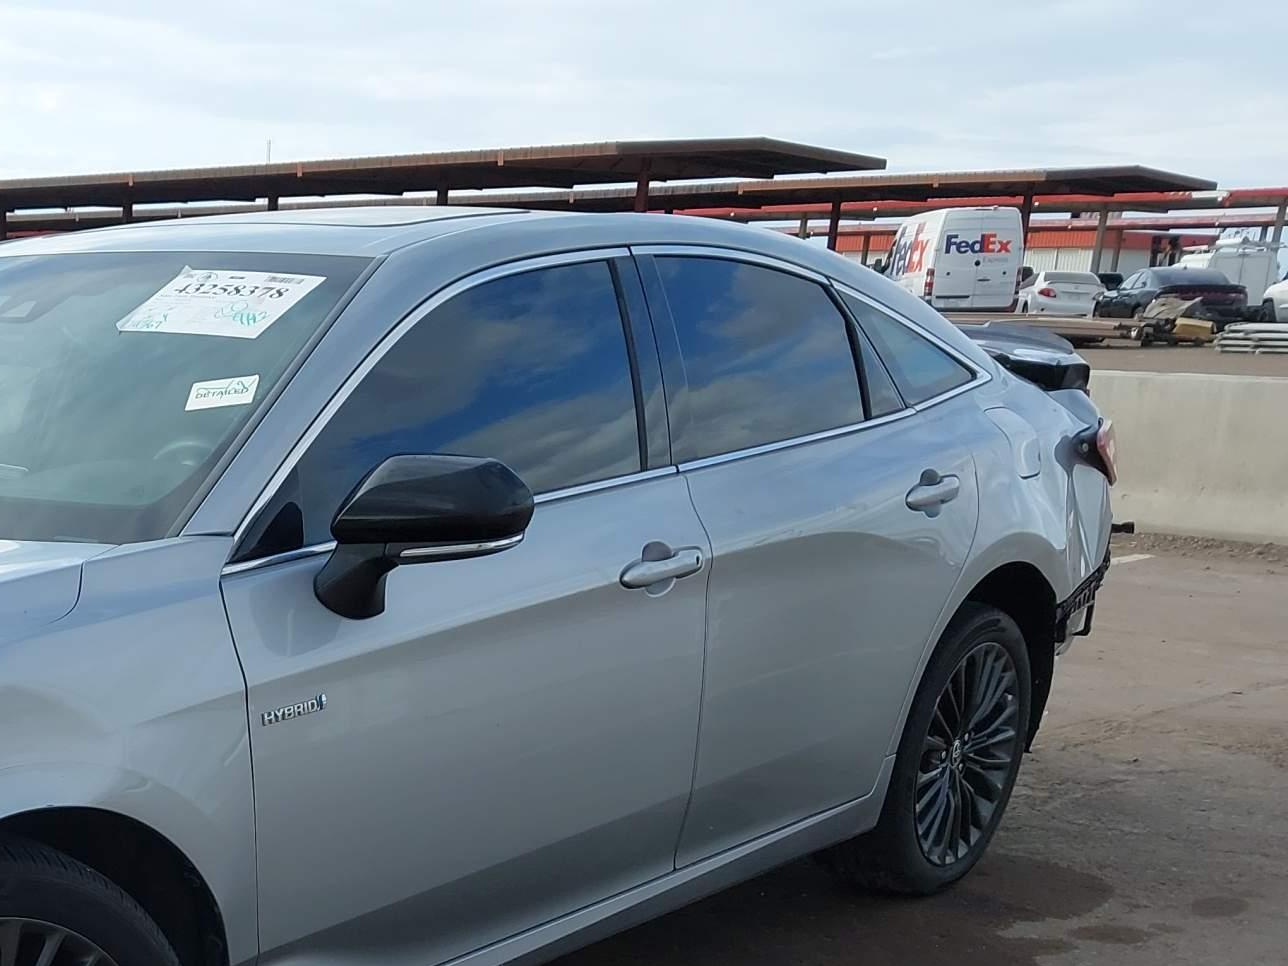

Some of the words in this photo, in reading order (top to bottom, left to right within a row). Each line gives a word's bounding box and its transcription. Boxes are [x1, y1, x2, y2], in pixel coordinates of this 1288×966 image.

[945, 233, 1011, 254] FedEx
[174, 283, 288, 299] 43258378
[262, 699, 320, 726] HYBRID
